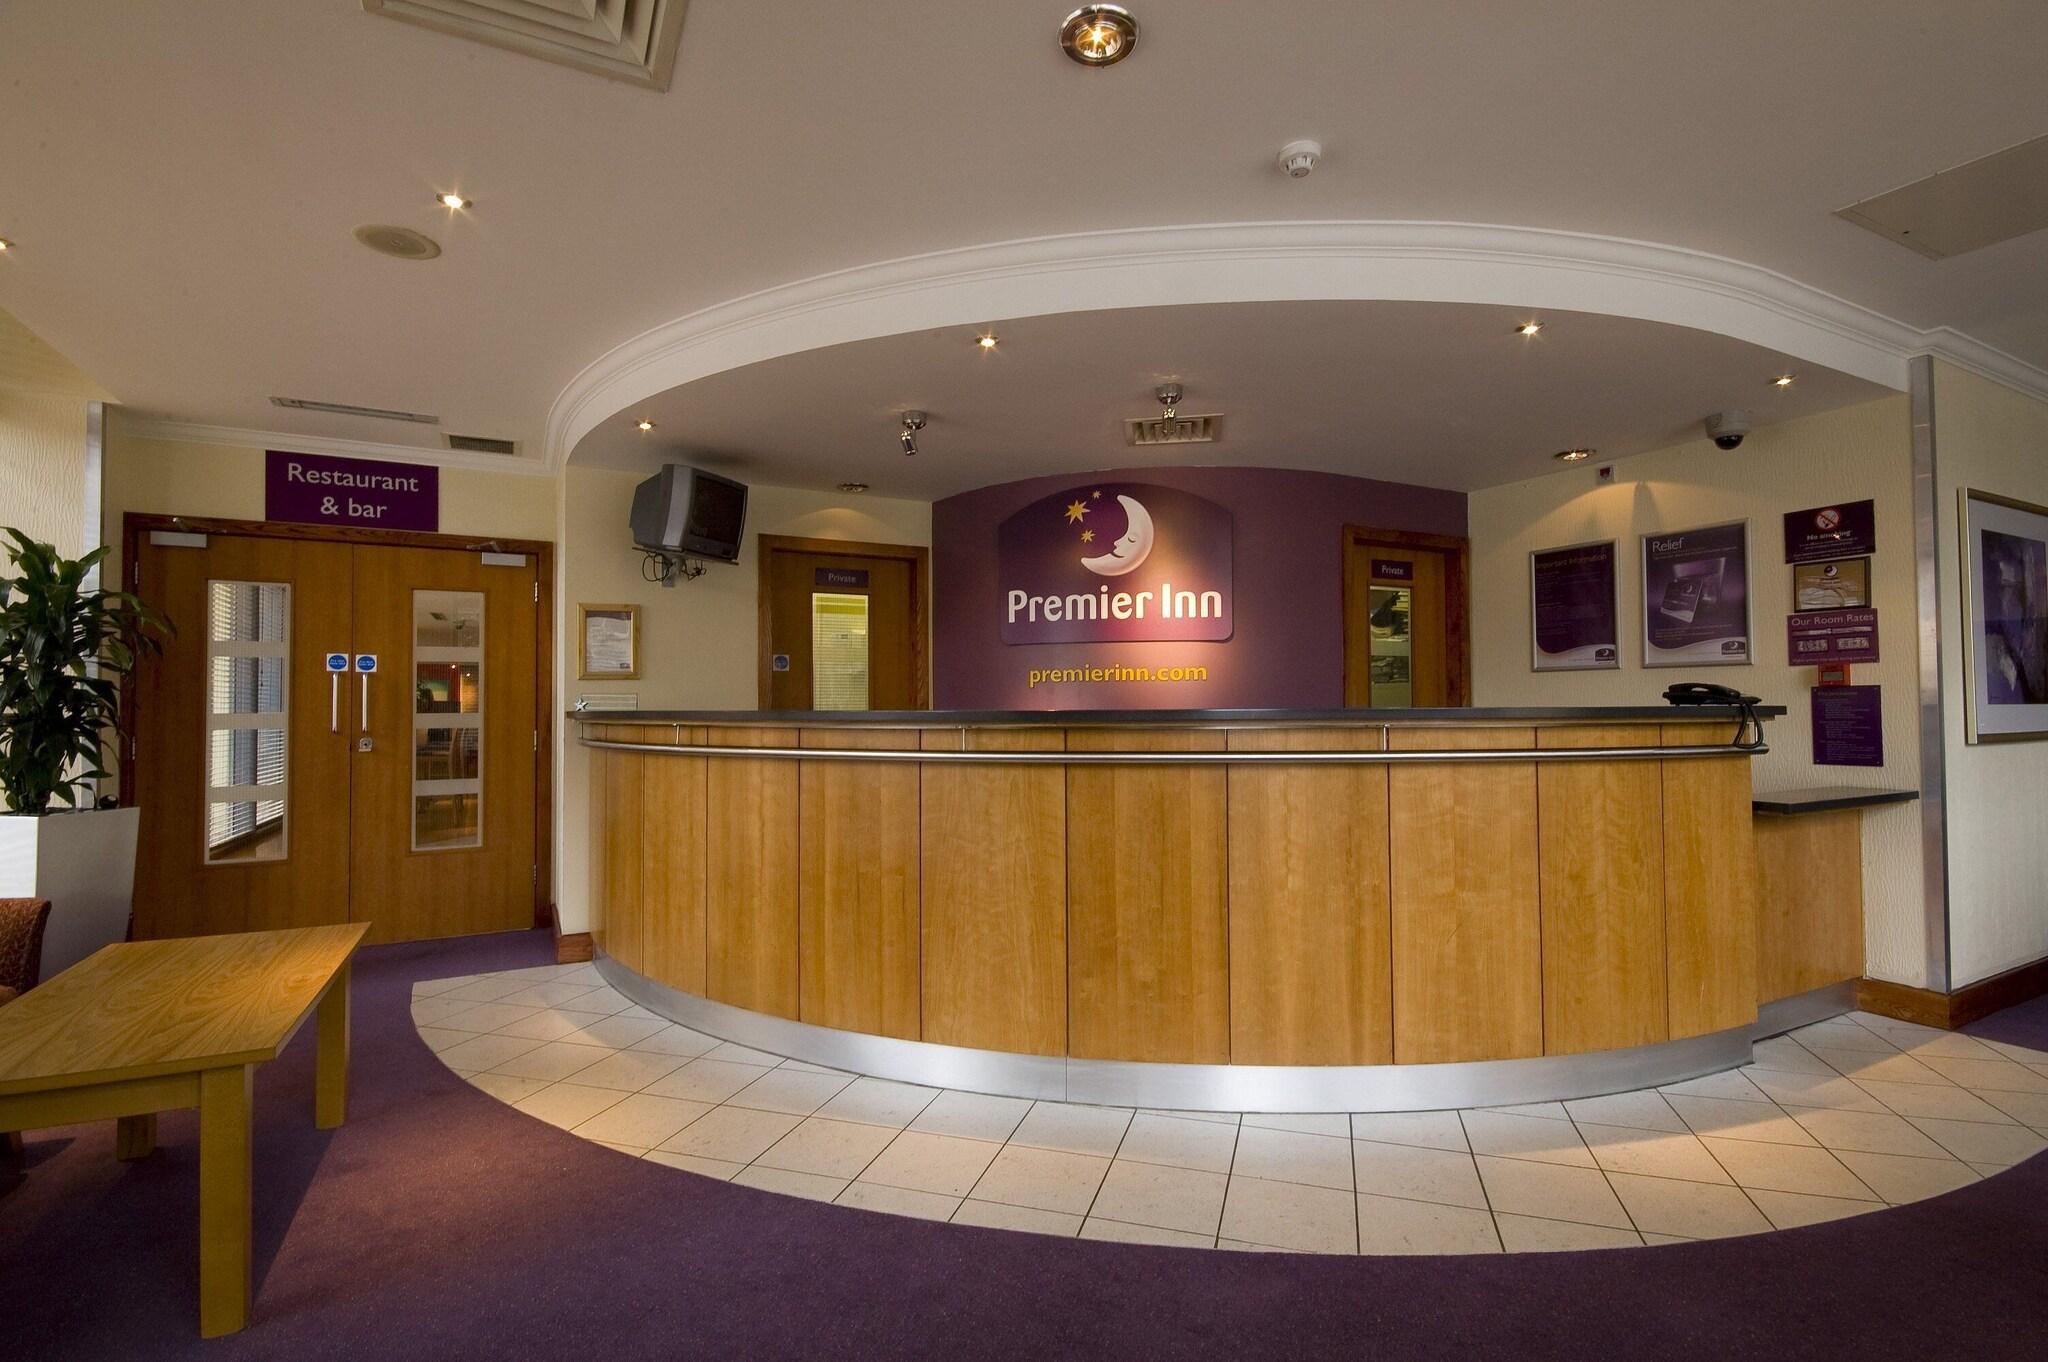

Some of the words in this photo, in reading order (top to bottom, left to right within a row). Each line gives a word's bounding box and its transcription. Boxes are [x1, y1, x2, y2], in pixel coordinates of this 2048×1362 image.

[288, 462, 419, 492] Restaurant
[320, 496, 339, 515] &
[348, 498, 387, 518] bar
[1652, 537, 1685, 552] Relief
[828, 572, 857, 583] Private
[1381, 565, 1404, 575] Private
[1008, 584, 1153, 623] Premier
[1162, 583, 1222, 619] Inn
[1791, 617, 1811, 626] Our
[1814, 615, 1844, 625] Room
[1846, 613, 1874, 622] Rates
[1029, 663, 1208, 688] premierinn.com
